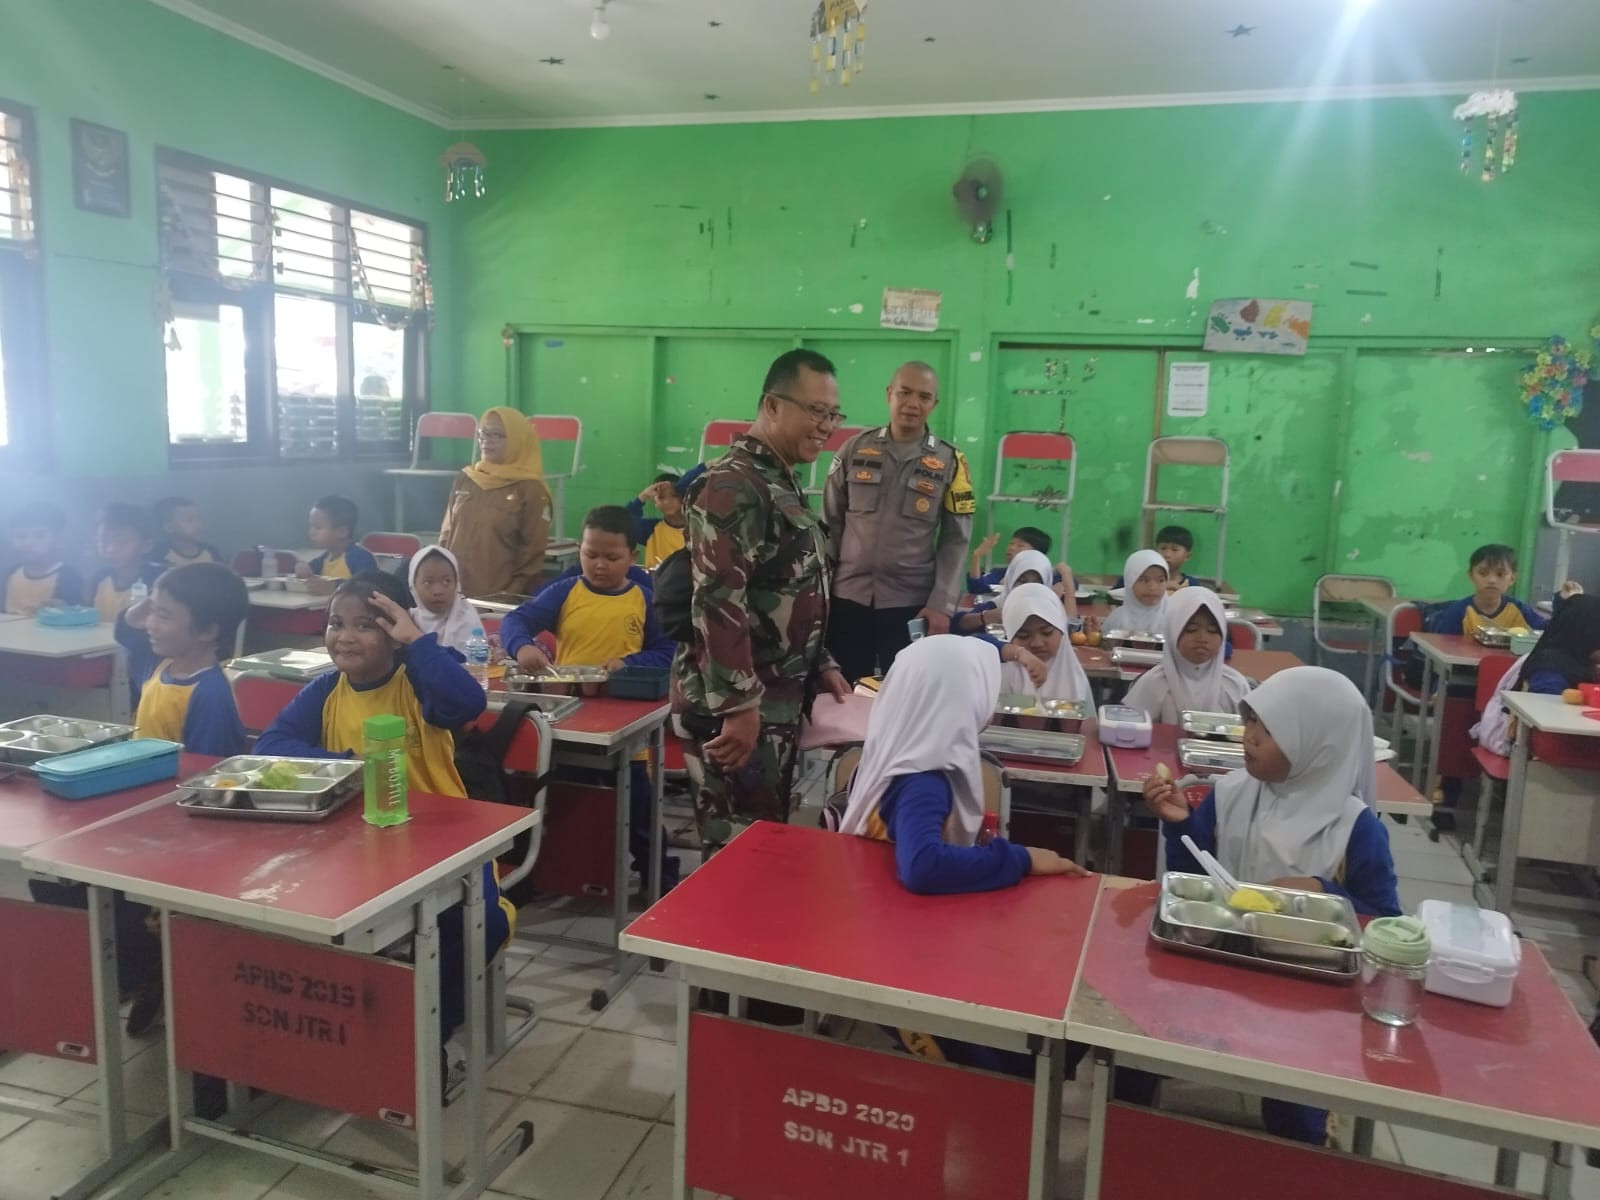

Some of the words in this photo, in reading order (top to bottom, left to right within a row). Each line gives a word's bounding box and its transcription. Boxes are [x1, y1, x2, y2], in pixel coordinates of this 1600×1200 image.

[242, 1001, 291, 1032] SDN
[782, 1087, 848, 1116] APBD
[855, 1103, 915, 1132] 2020
[784, 1121, 833, 1150] SDN
[841, 1136, 889, 1163] JTR
[897, 1149, 910, 1167] 1
